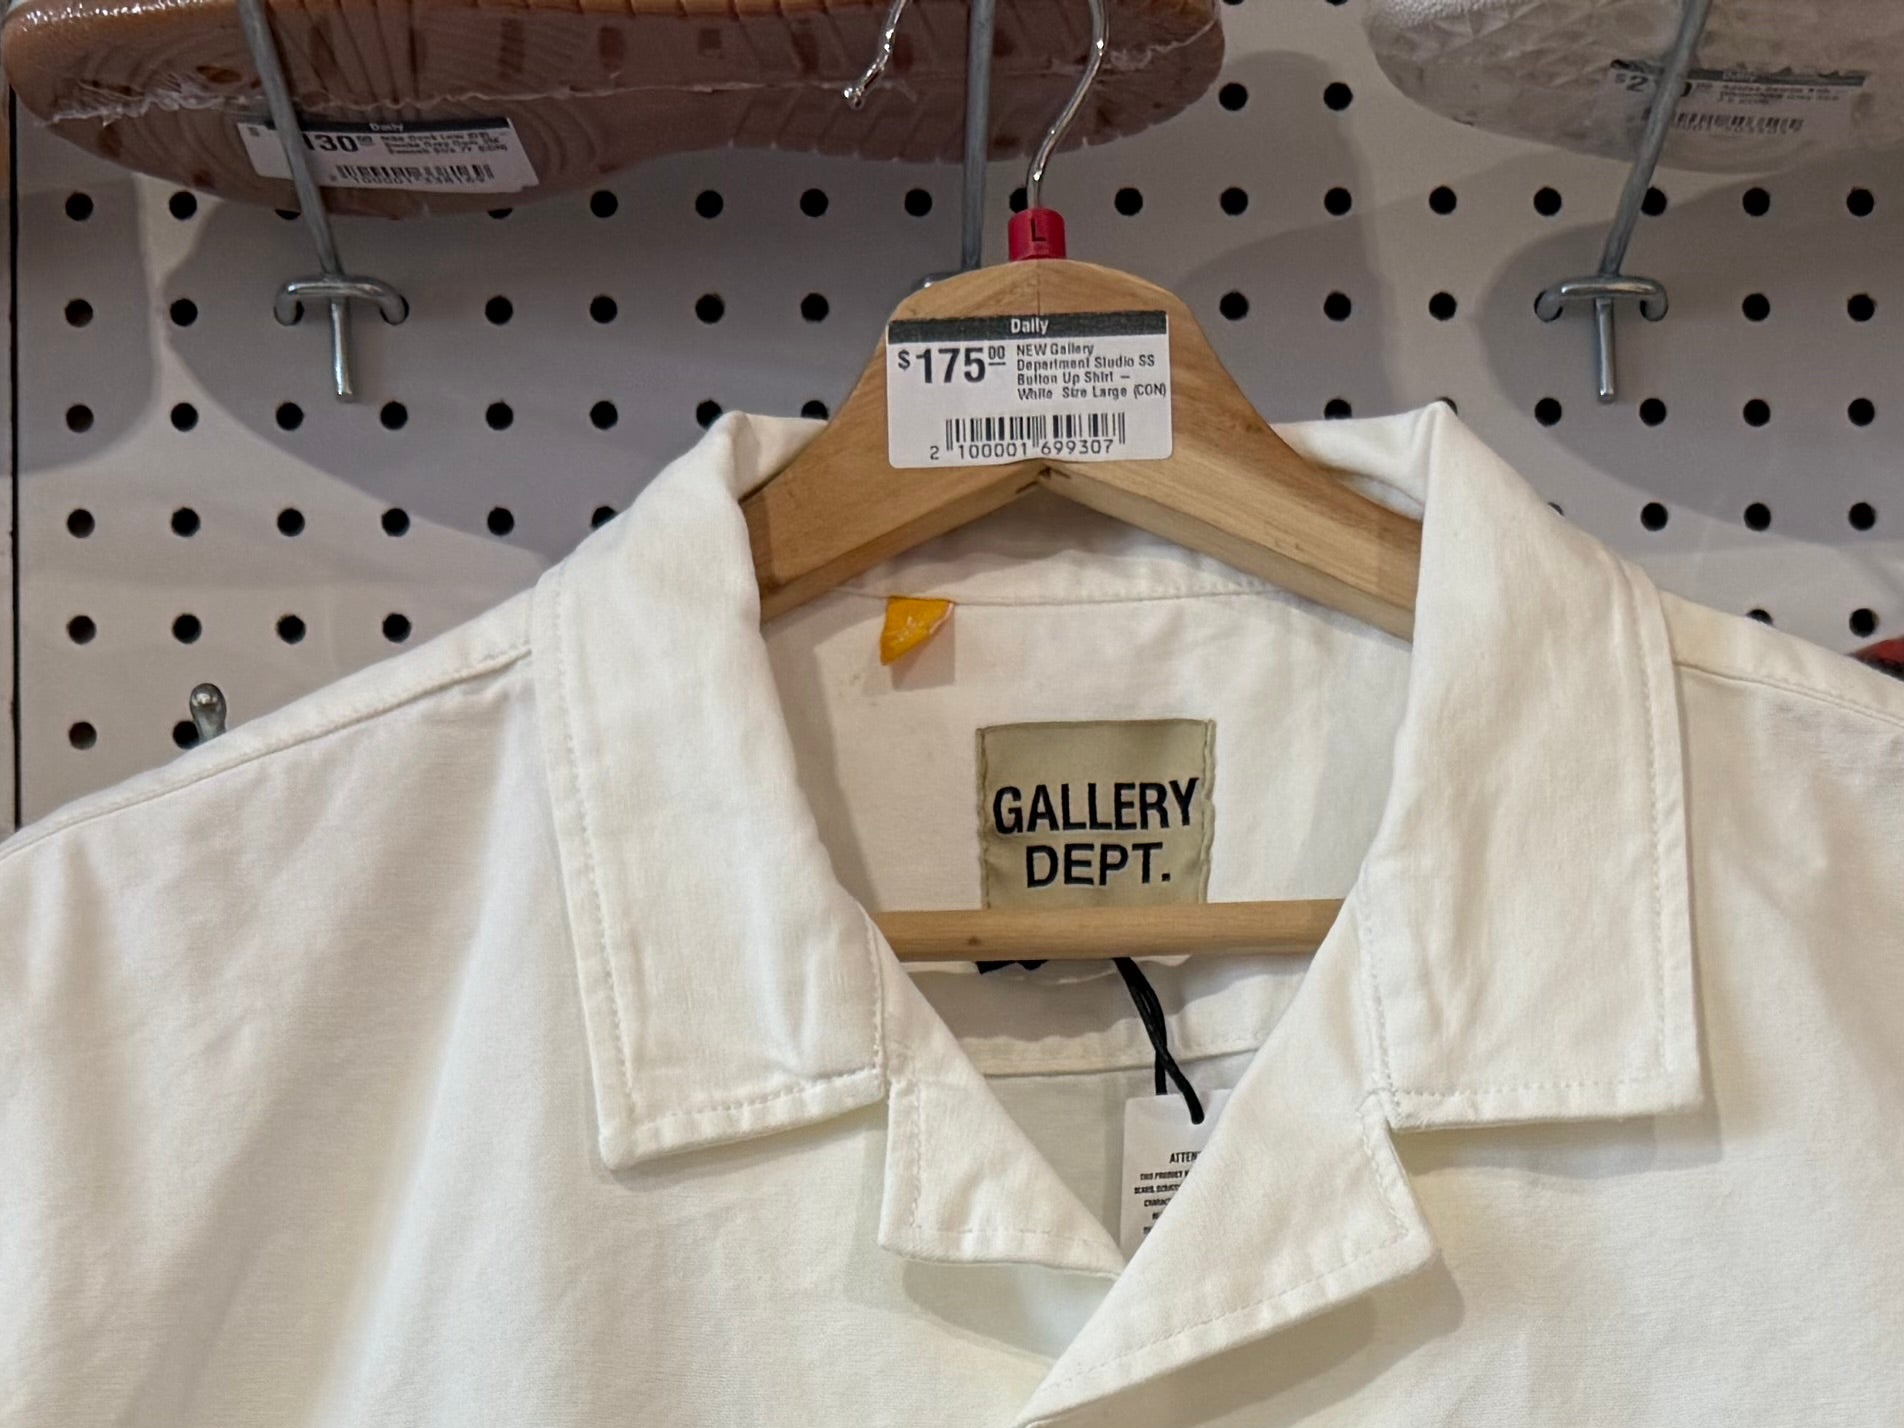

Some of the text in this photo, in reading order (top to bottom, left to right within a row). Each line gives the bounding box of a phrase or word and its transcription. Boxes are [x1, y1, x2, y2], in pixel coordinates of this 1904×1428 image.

[1030, 219, 1047, 242] L
[1010, 318, 1049, 335] Daily
[1016, 343, 1094, 358] NEW Gallery
[1017, 354, 1156, 374] Department Studio SS
[1017, 373, 1058, 387] Button
[1062, 372, 1081, 387] Up
[1084, 371, 1114, 384] Shirt
[1018, 387, 1053, 401] White
[1092, 385, 1128, 401] Large
[1132, 382, 1167, 400] (CON)
[929, 439, 1114, 461] 2 100001 699307
[992, 776, 1200, 835] GALLERY
[1025, 841, 1171, 889] DEPT.
[1169, 1150, 1202, 1164] ATTEN
